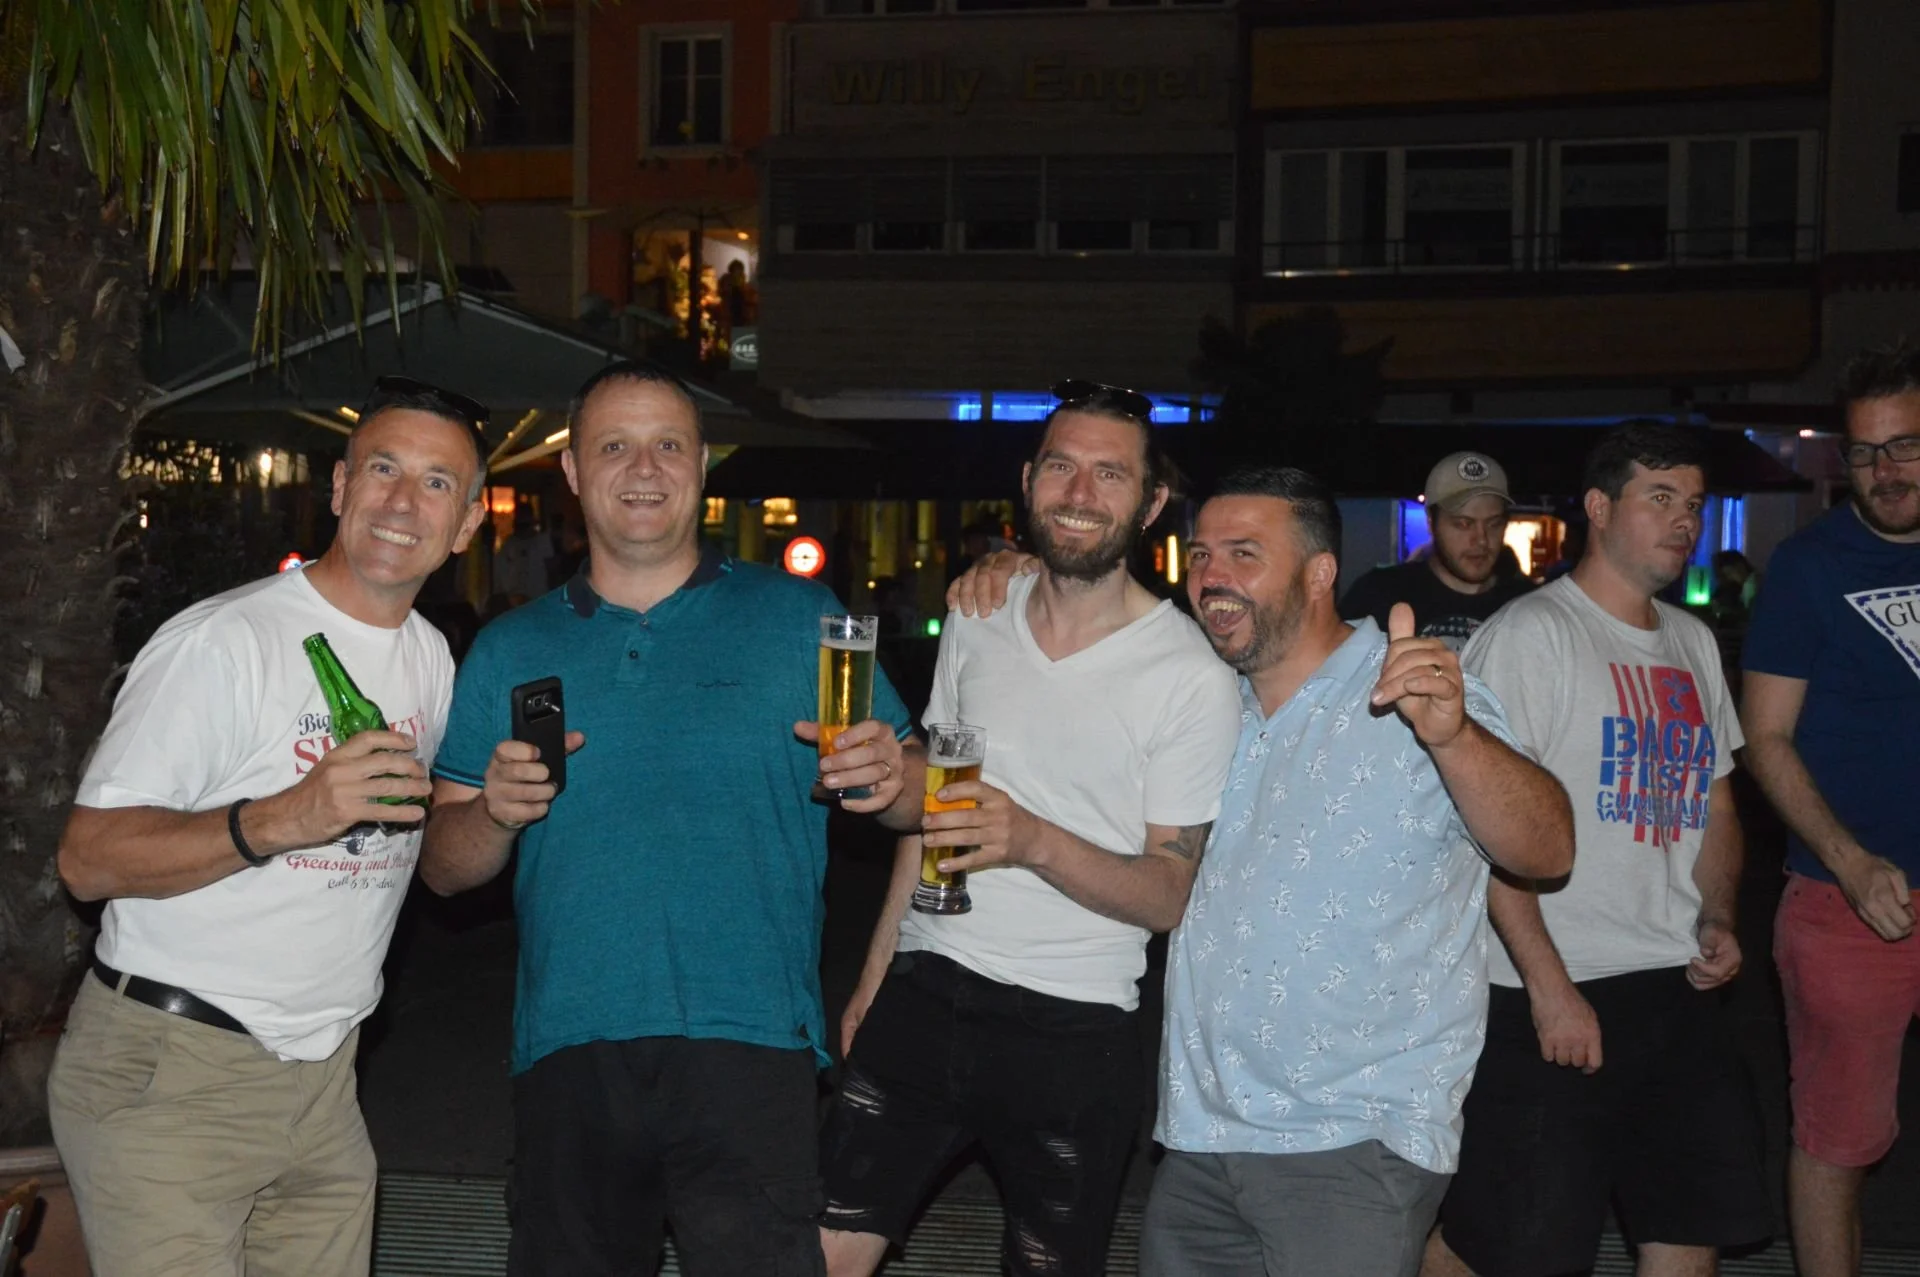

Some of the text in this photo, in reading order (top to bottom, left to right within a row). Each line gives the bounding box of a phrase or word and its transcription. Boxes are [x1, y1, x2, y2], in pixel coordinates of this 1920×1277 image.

[828, 52, 1213, 116] Willy Engel
[1602, 716, 1716, 766] BAGA
